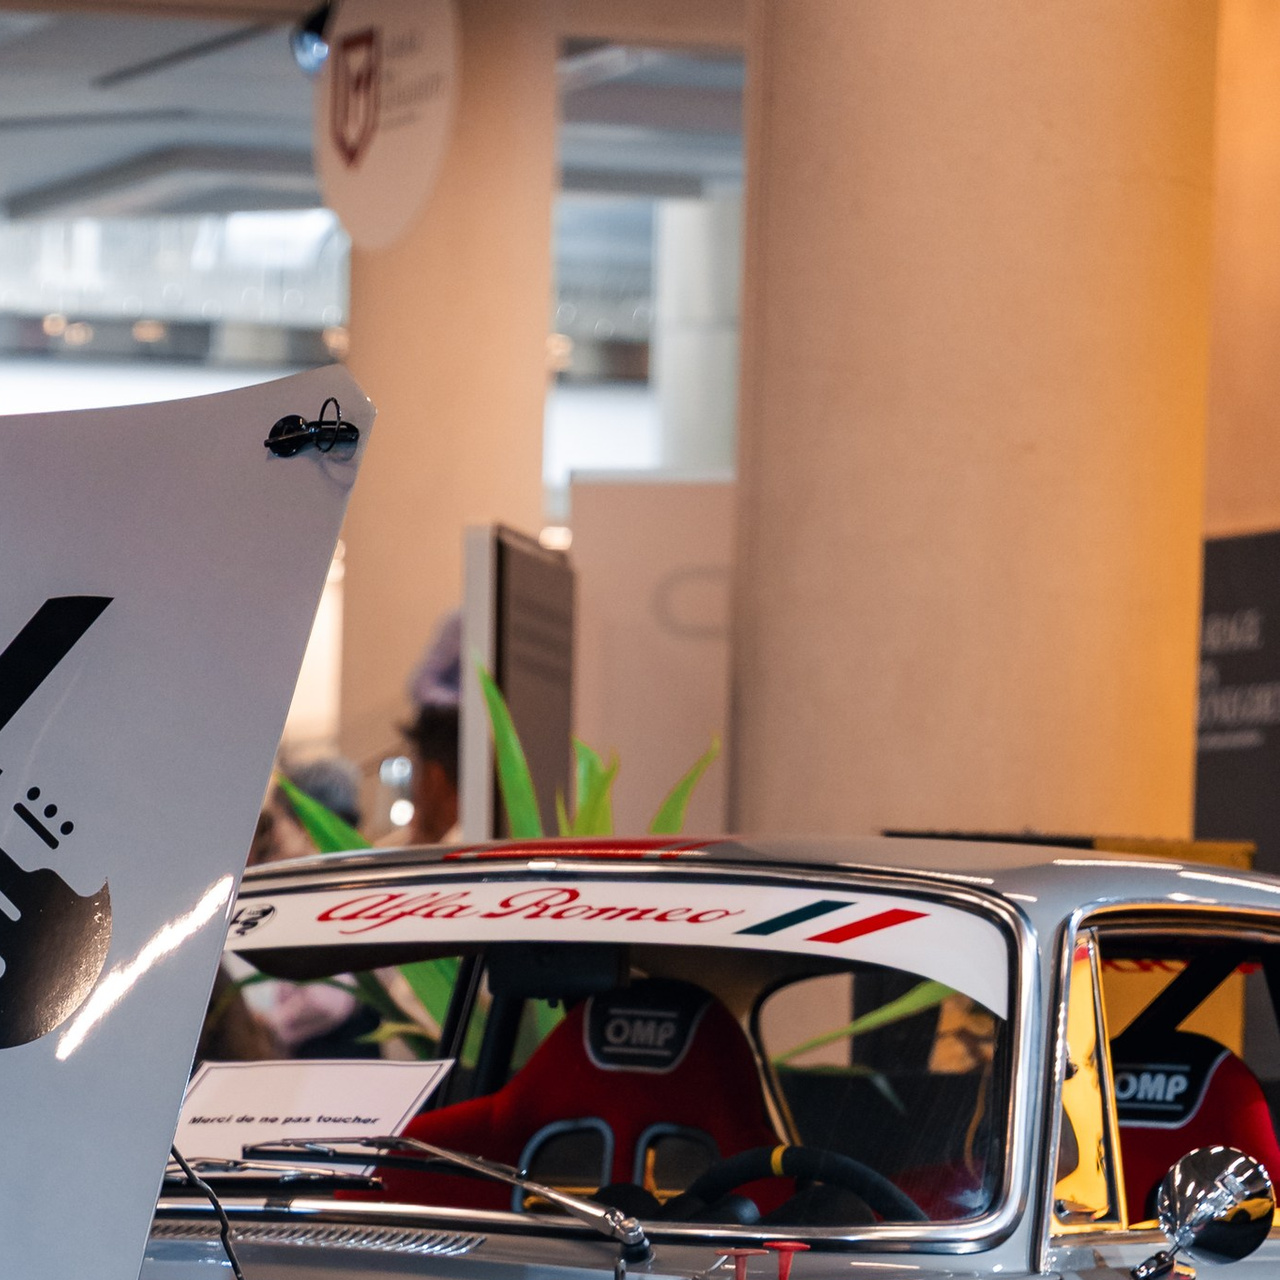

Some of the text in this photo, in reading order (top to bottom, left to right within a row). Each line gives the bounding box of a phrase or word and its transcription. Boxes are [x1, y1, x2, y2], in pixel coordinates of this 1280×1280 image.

[317, 887, 746, 935] Alfa Romeo
[605, 1018, 677, 1047] OMP
[1115, 1071, 1188, 1102] OMP
[188, 1114, 380, 1126] Merci de ne pas toucher
